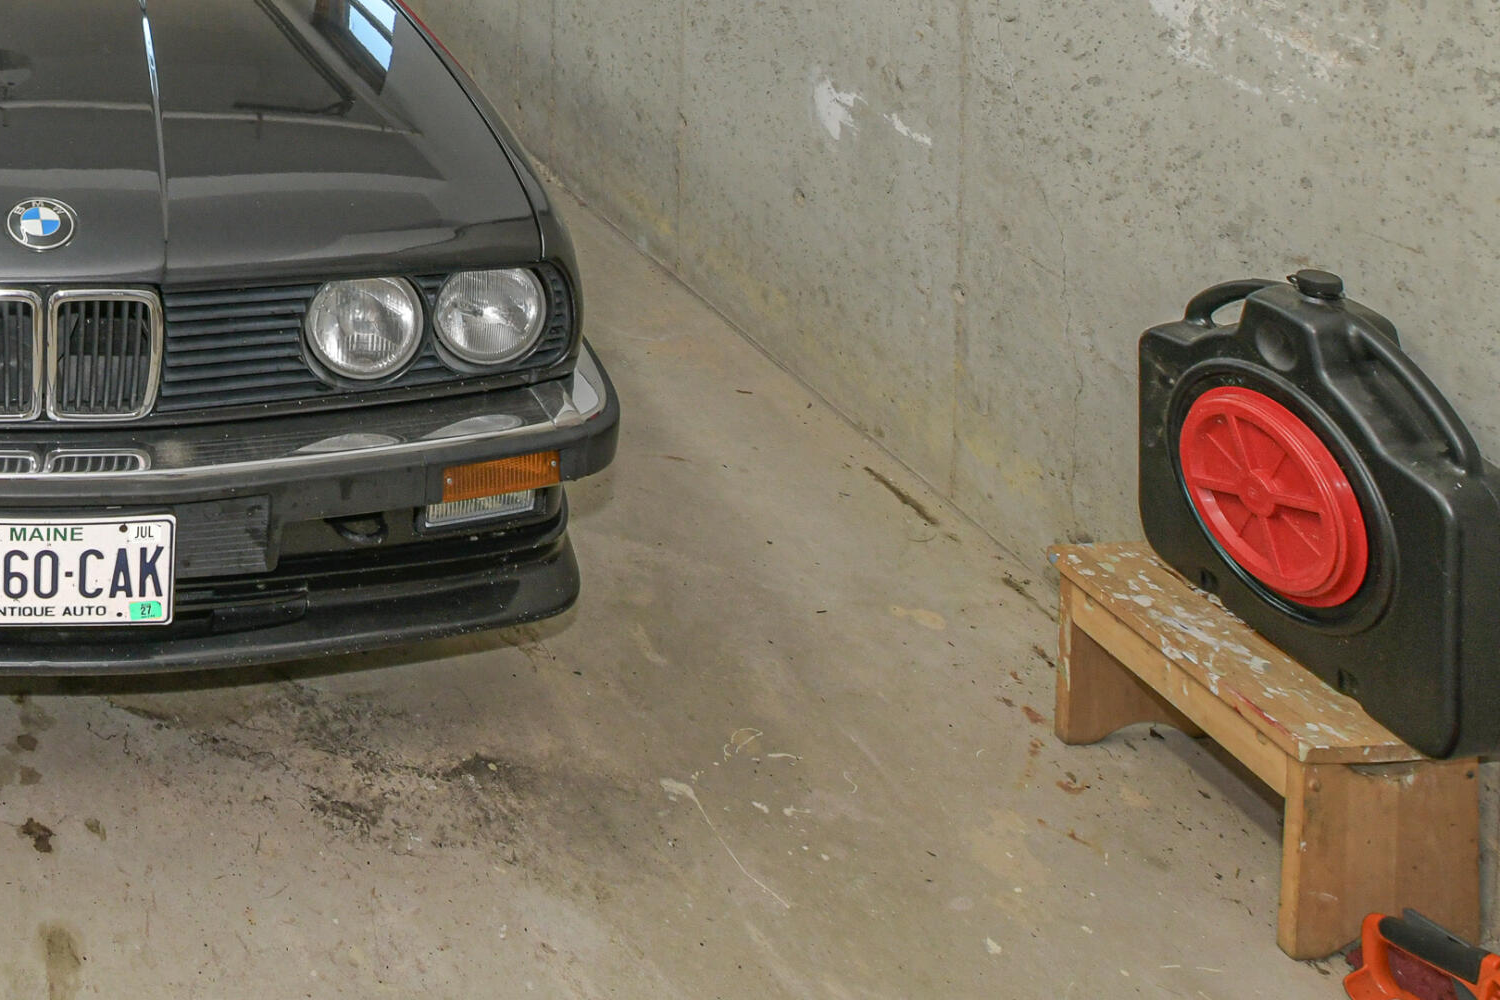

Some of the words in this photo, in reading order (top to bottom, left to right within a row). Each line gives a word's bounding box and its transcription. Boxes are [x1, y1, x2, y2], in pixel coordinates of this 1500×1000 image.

[9, 526, 85, 542] MAINE
[134, 525, 155, 539] JUL
[62, 605, 107, 617] AUTO
[140, 605, 152, 616] 27
